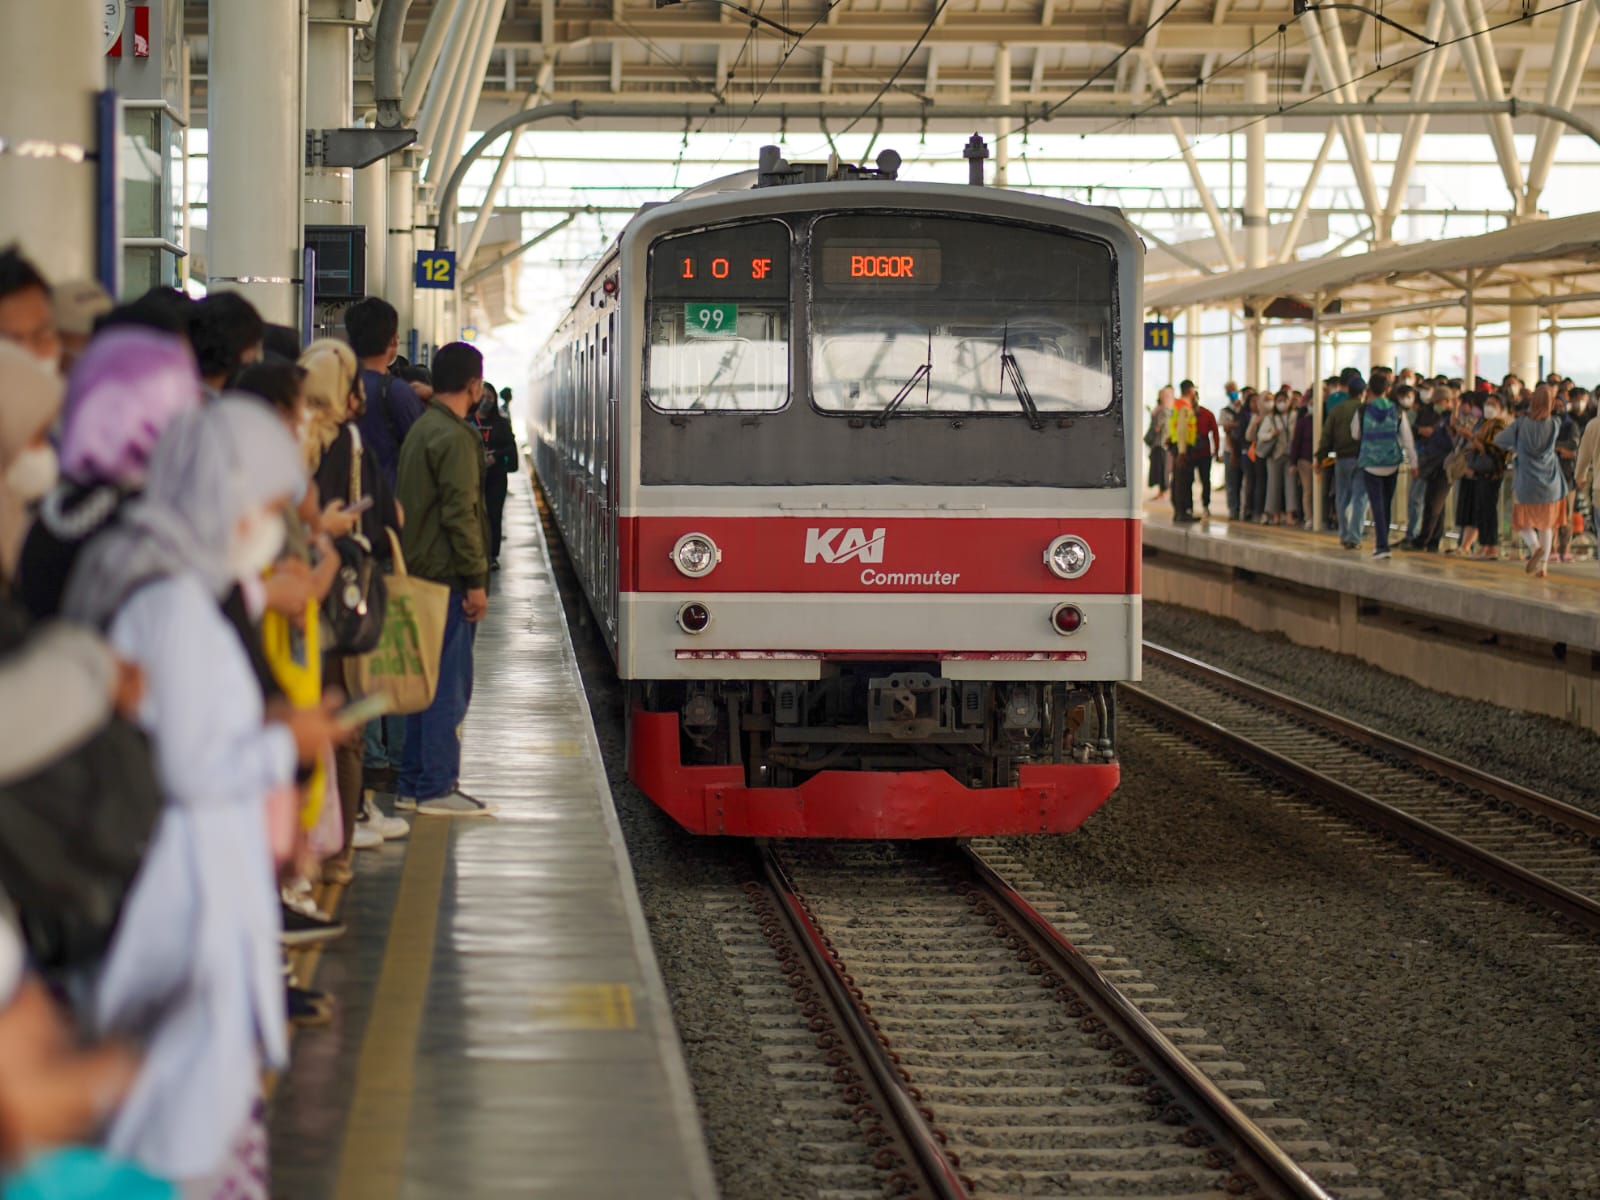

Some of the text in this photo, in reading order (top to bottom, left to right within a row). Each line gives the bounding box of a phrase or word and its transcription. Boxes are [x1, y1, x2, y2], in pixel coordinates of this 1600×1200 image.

[422, 258, 450, 281] 12
[751, 257, 772, 279] SF
[851, 255, 914, 277] BOGOR
[699, 309, 724, 329] 99
[1150, 328, 1168, 347] 11
[804, 527, 886, 564] KAI
[860, 568, 960, 585] Commuter
